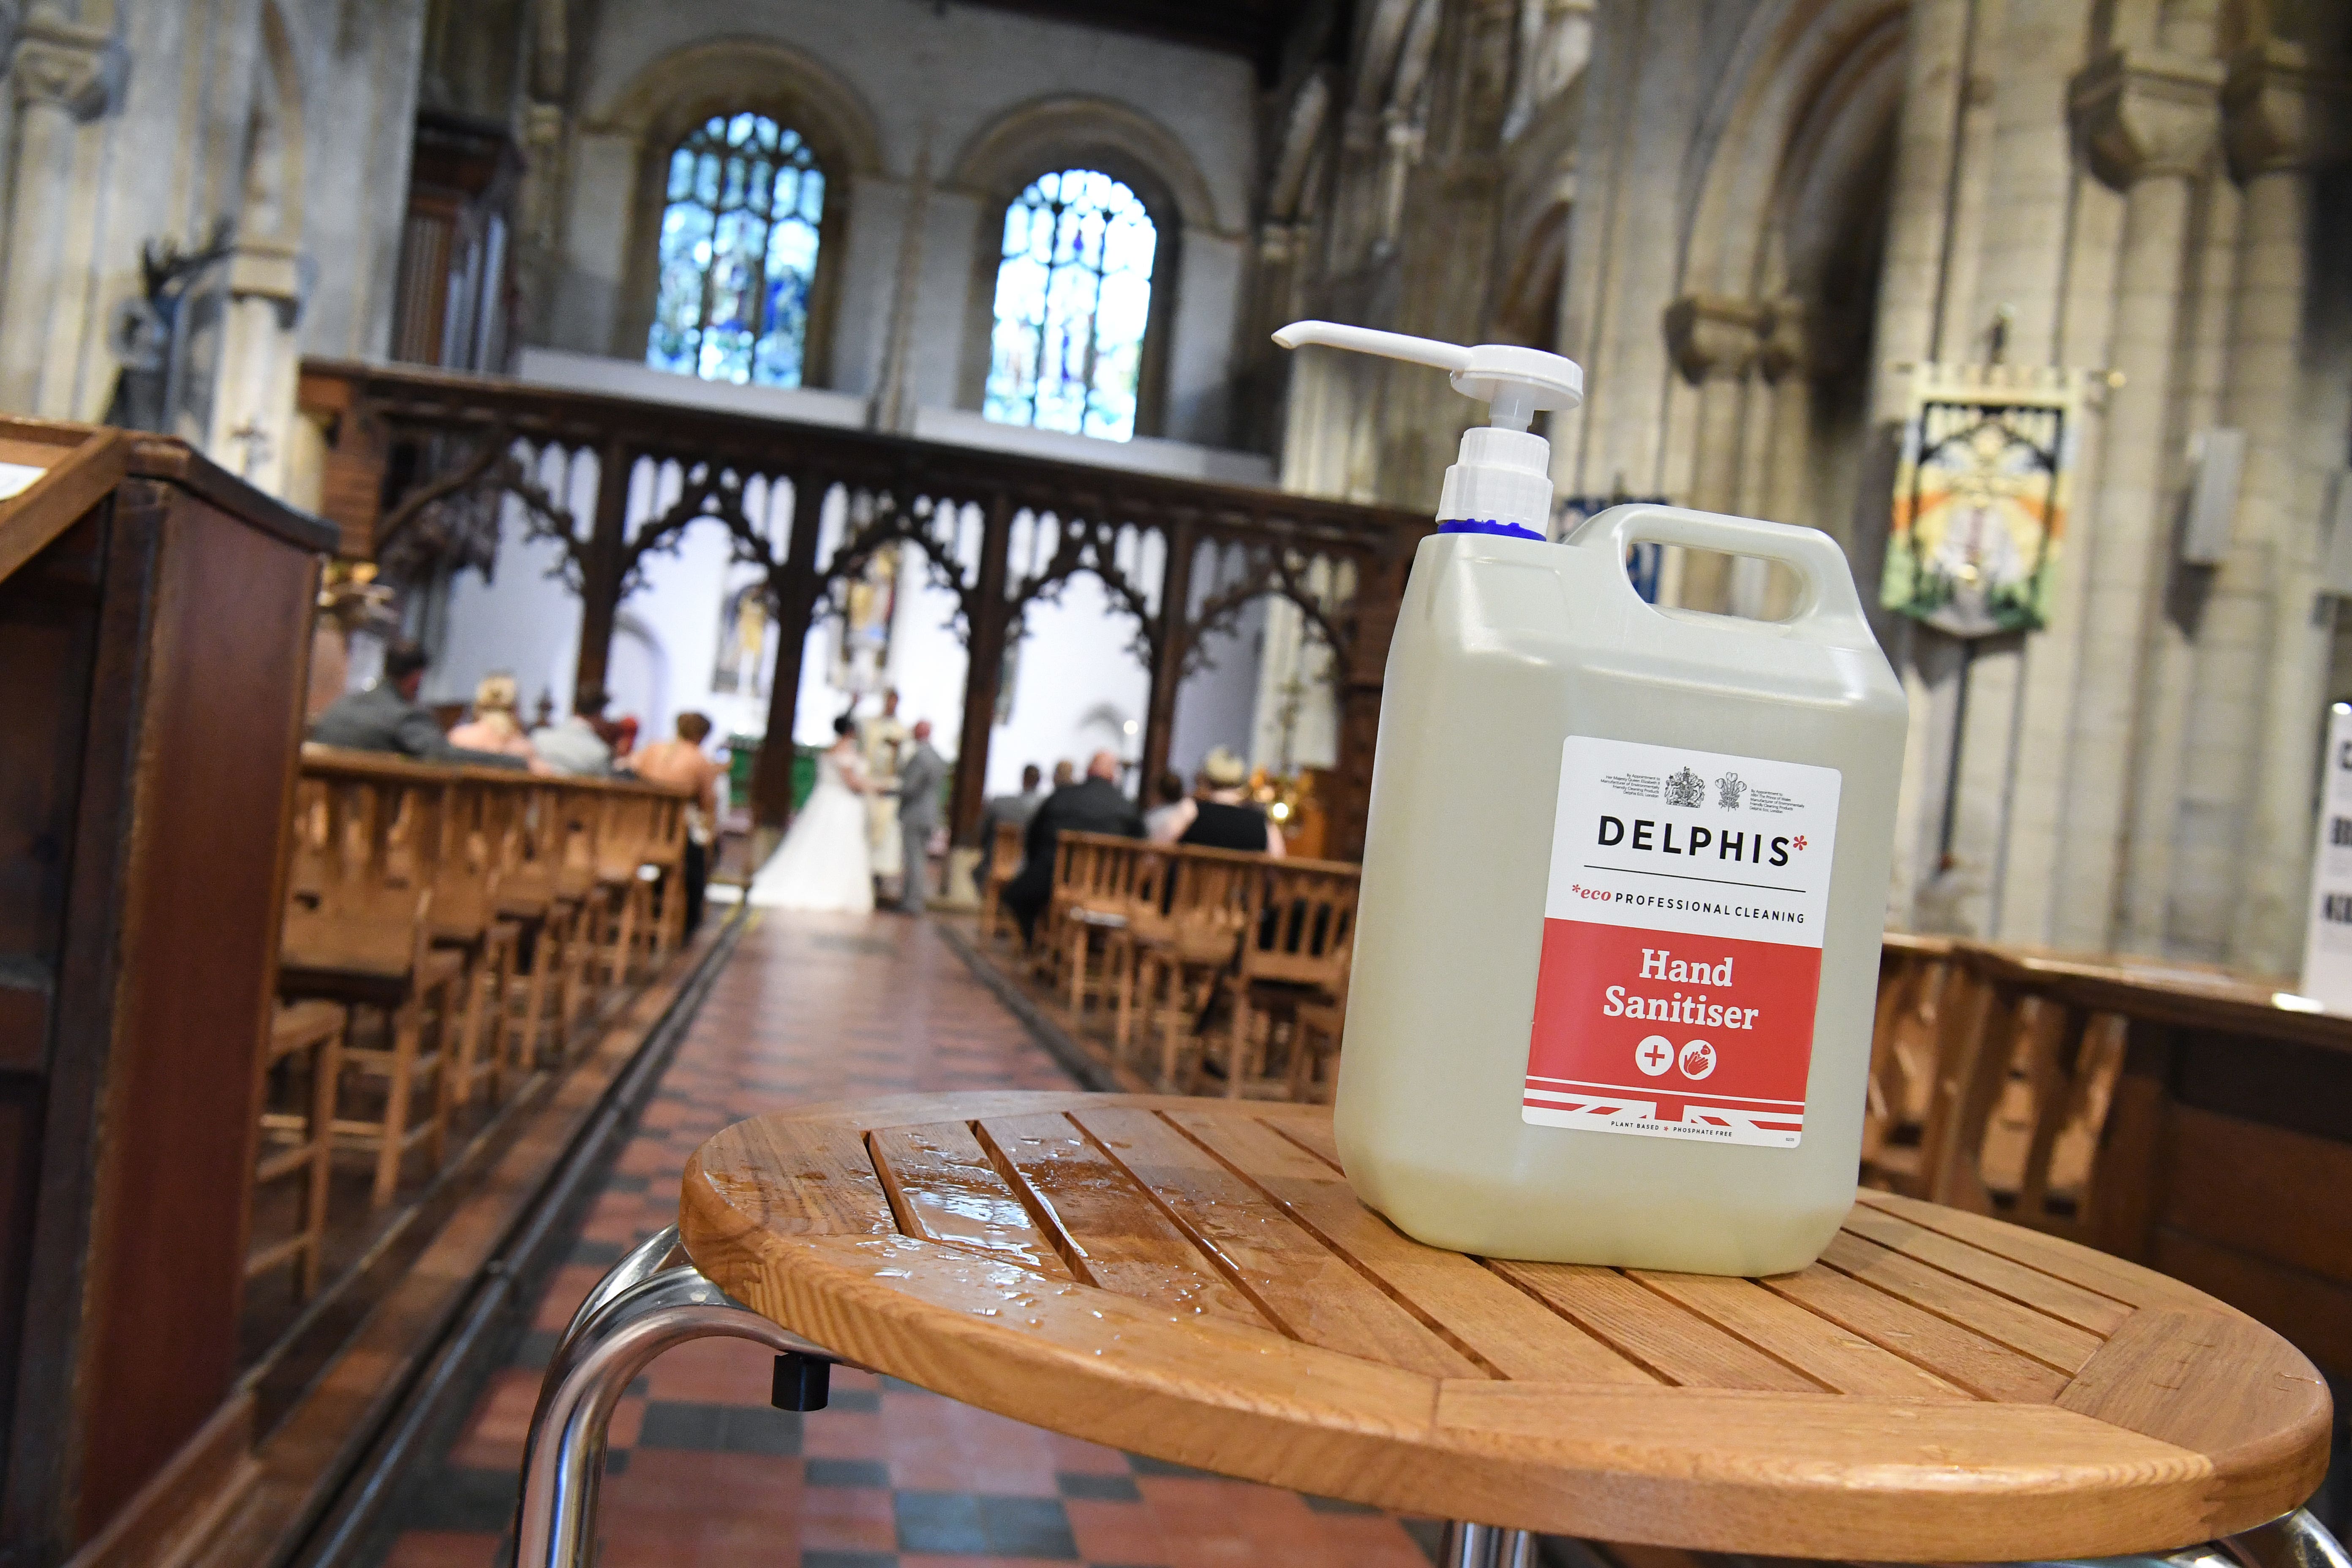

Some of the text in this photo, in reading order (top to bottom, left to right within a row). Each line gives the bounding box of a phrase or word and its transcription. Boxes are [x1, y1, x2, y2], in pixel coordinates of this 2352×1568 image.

[1615, 893, 1730, 915] PROFESSIONAL
[1735, 906, 1804, 923] CLEANING
[1639, 948, 1733, 987] Hand
[1603, 985, 1759, 1030] Sanitiser
[1673, 1127, 1713, 1135] PHOSPHATE
